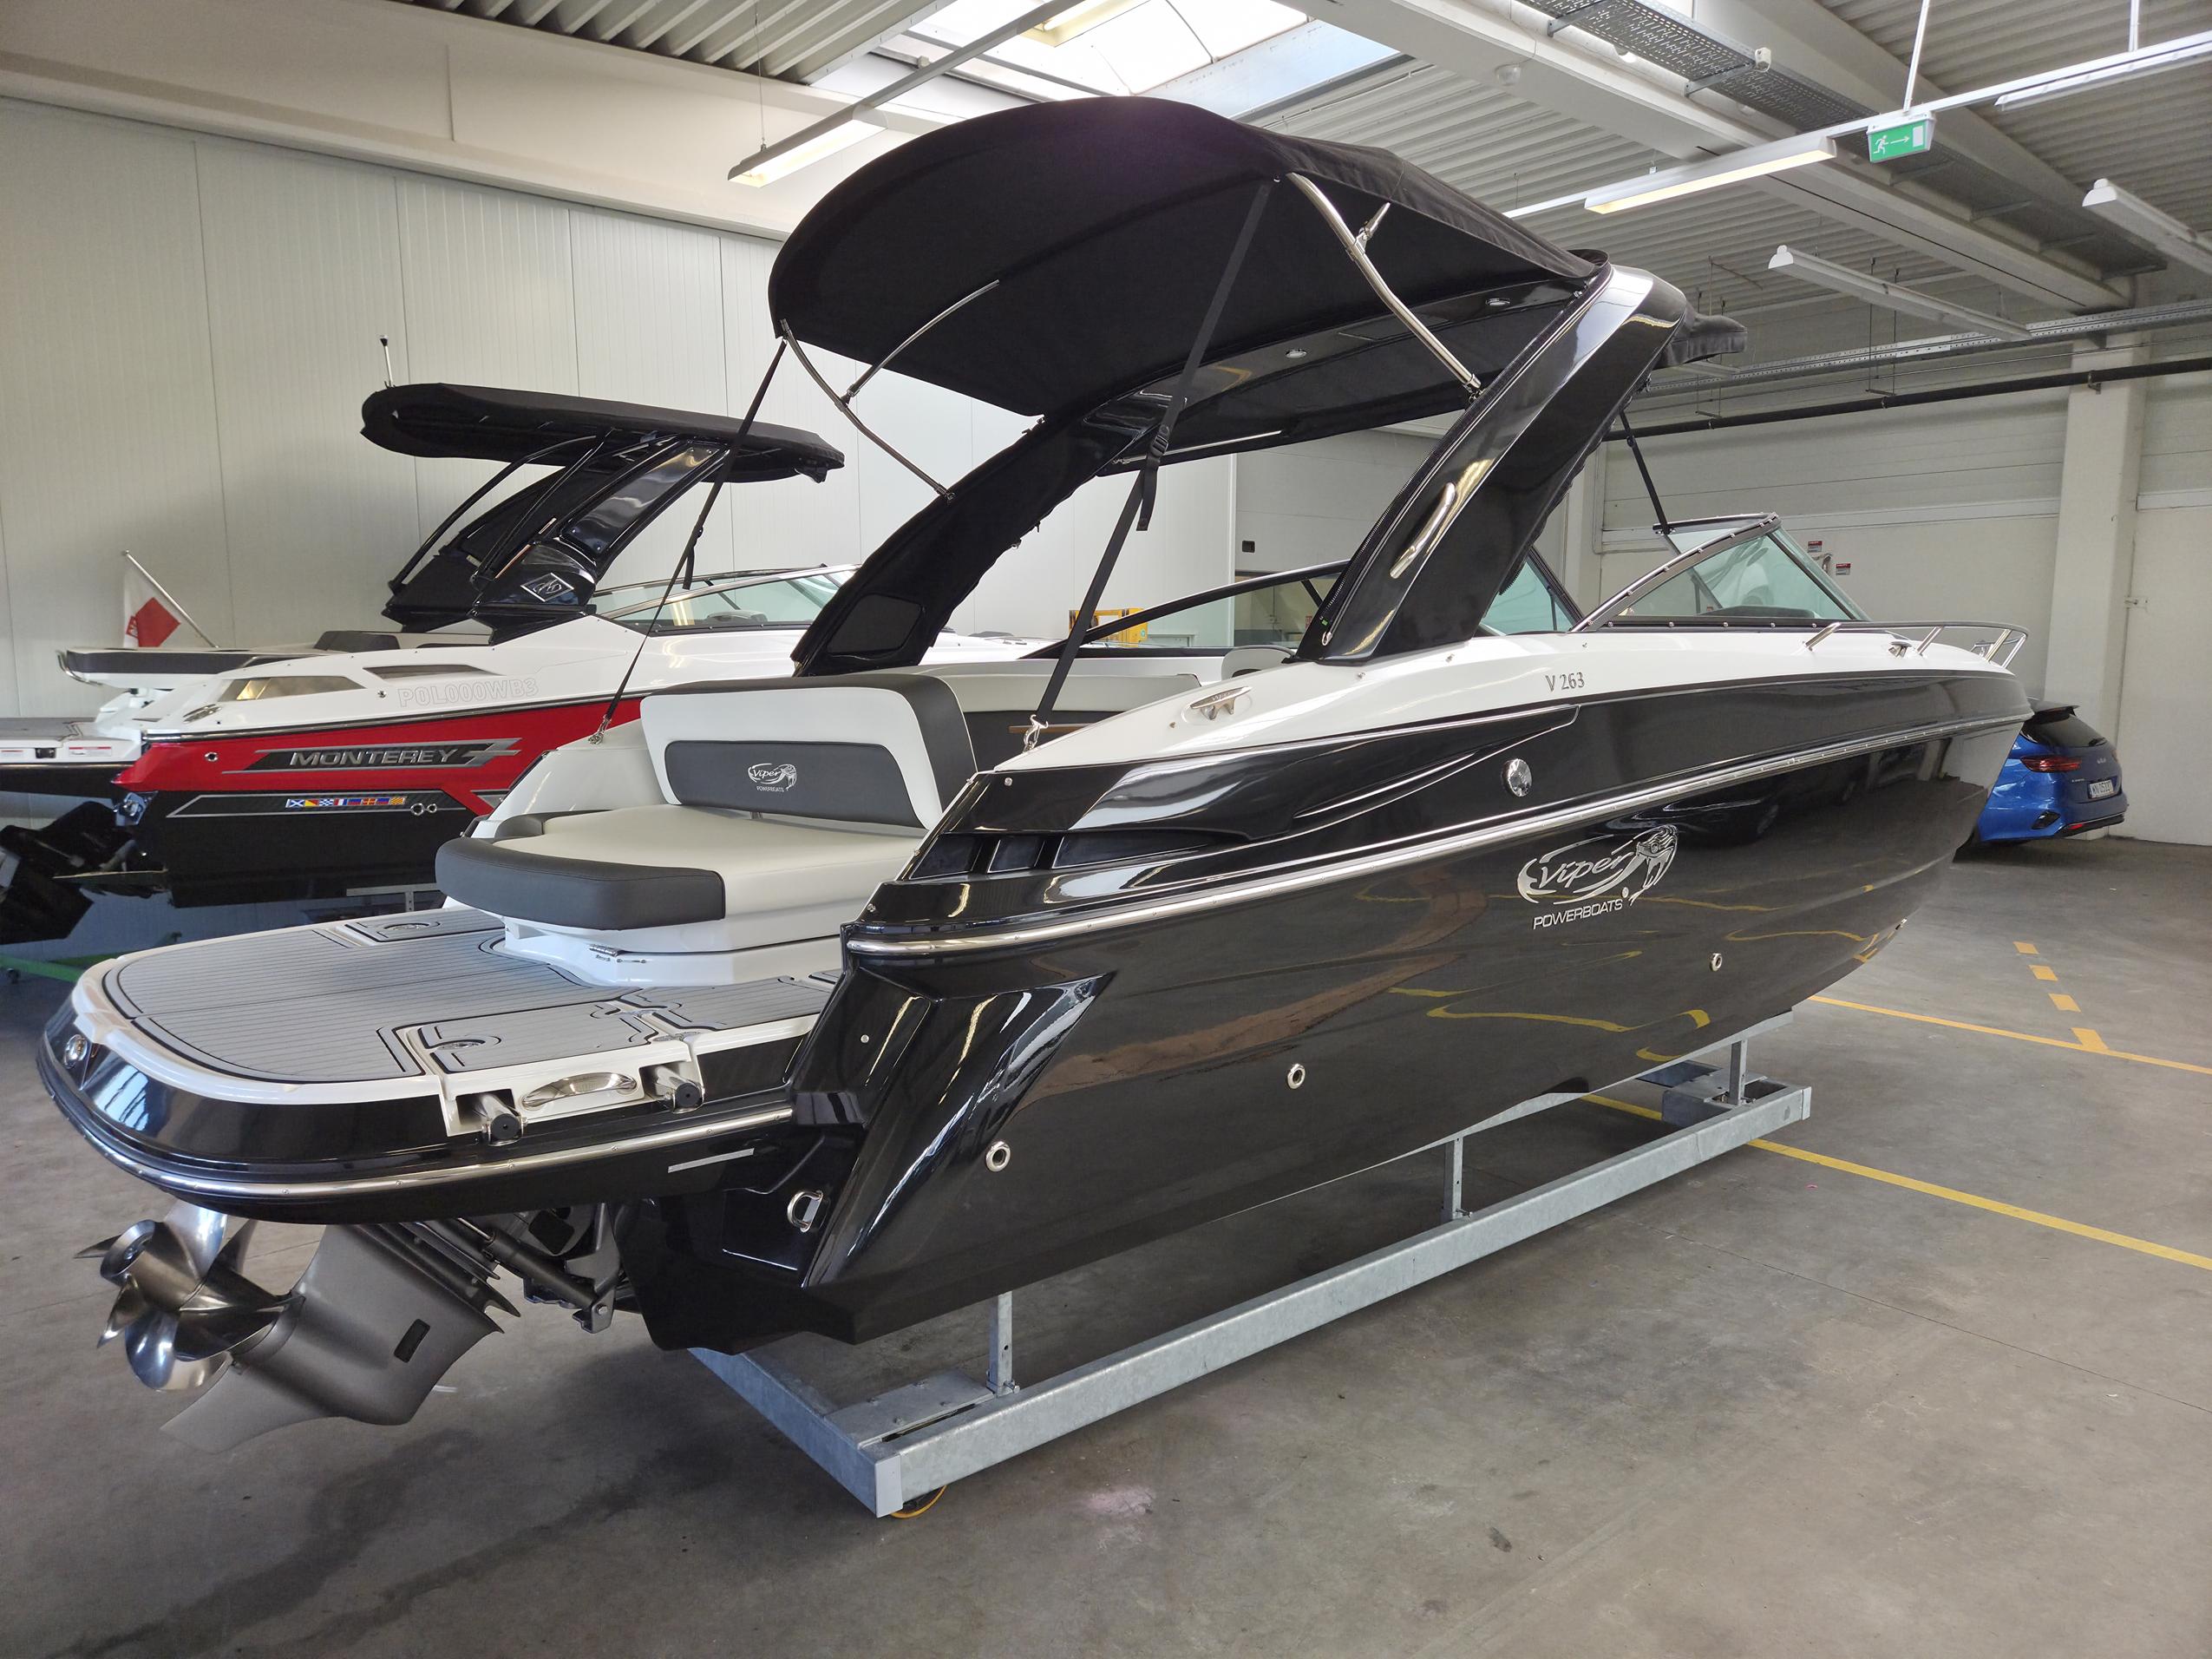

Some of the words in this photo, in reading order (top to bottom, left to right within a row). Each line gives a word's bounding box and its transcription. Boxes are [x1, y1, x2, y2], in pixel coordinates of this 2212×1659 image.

[1545, 674, 1556, 692] V
[1559, 672, 1585, 690] 263
[290, 749, 458, 766] MONTEREY
[753, 769, 782, 779] Viper
[1538, 851, 1635, 889] Viper
[1533, 898, 1623, 929] POWERBOATS
